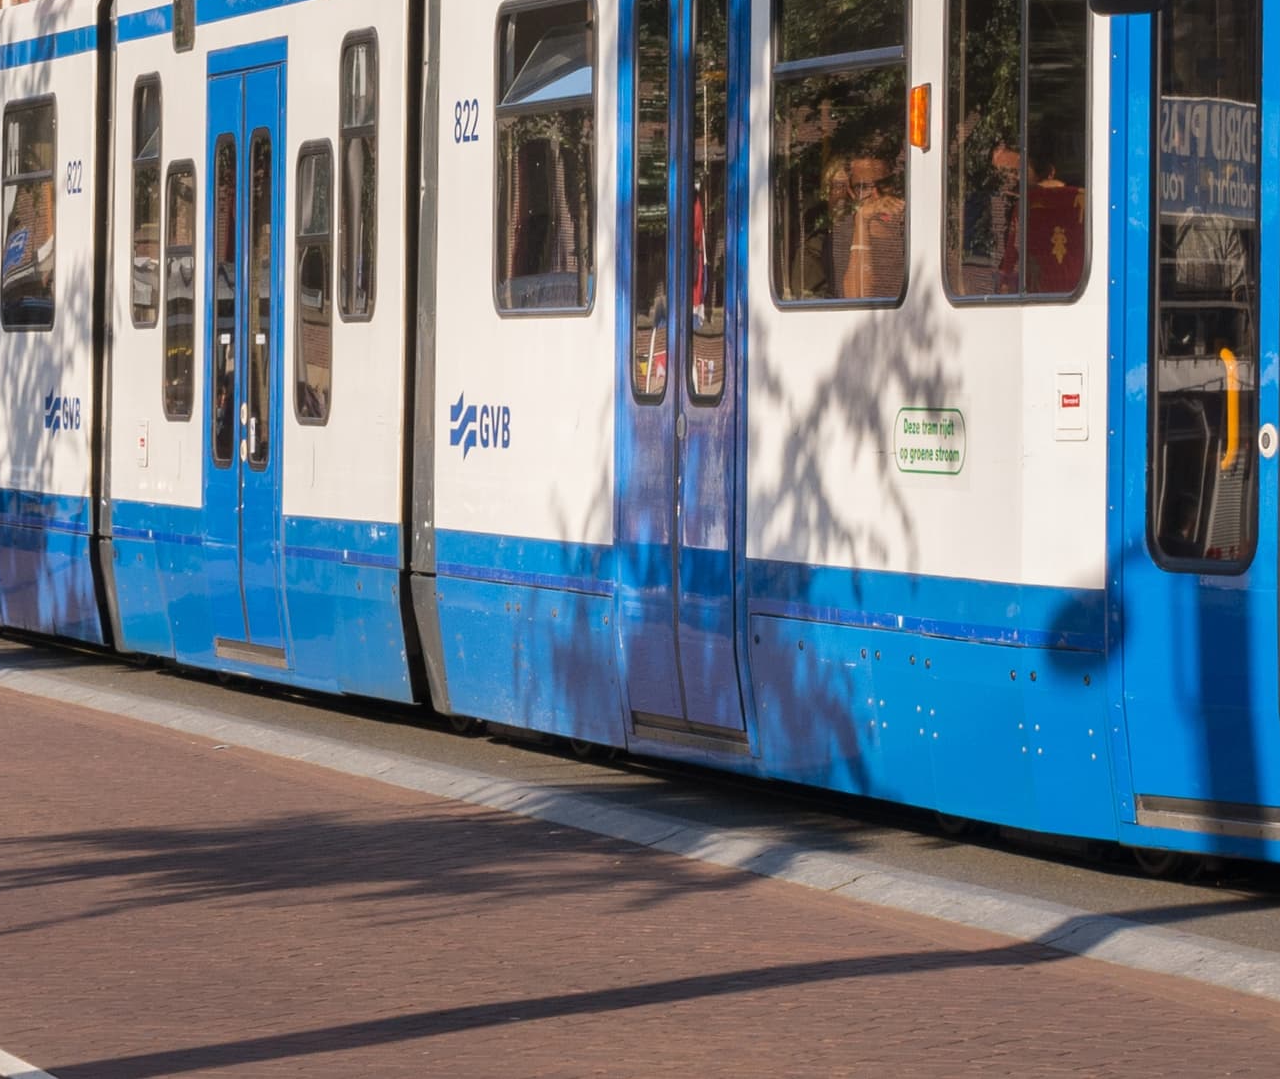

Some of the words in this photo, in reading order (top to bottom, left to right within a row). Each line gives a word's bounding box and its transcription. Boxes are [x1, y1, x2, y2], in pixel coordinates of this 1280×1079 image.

[454, 98, 479, 143] 822
[67, 160, 82, 194] 822
[62, 396, 80, 430] GVB
[480, 404, 510, 449] GVB
[903, 418, 921, 434] Deze
[922, 419, 938, 435] tram
[900, 448, 908, 464] op
[910, 448, 933, 464] groene
[935, 446, 960, 462] stroom
